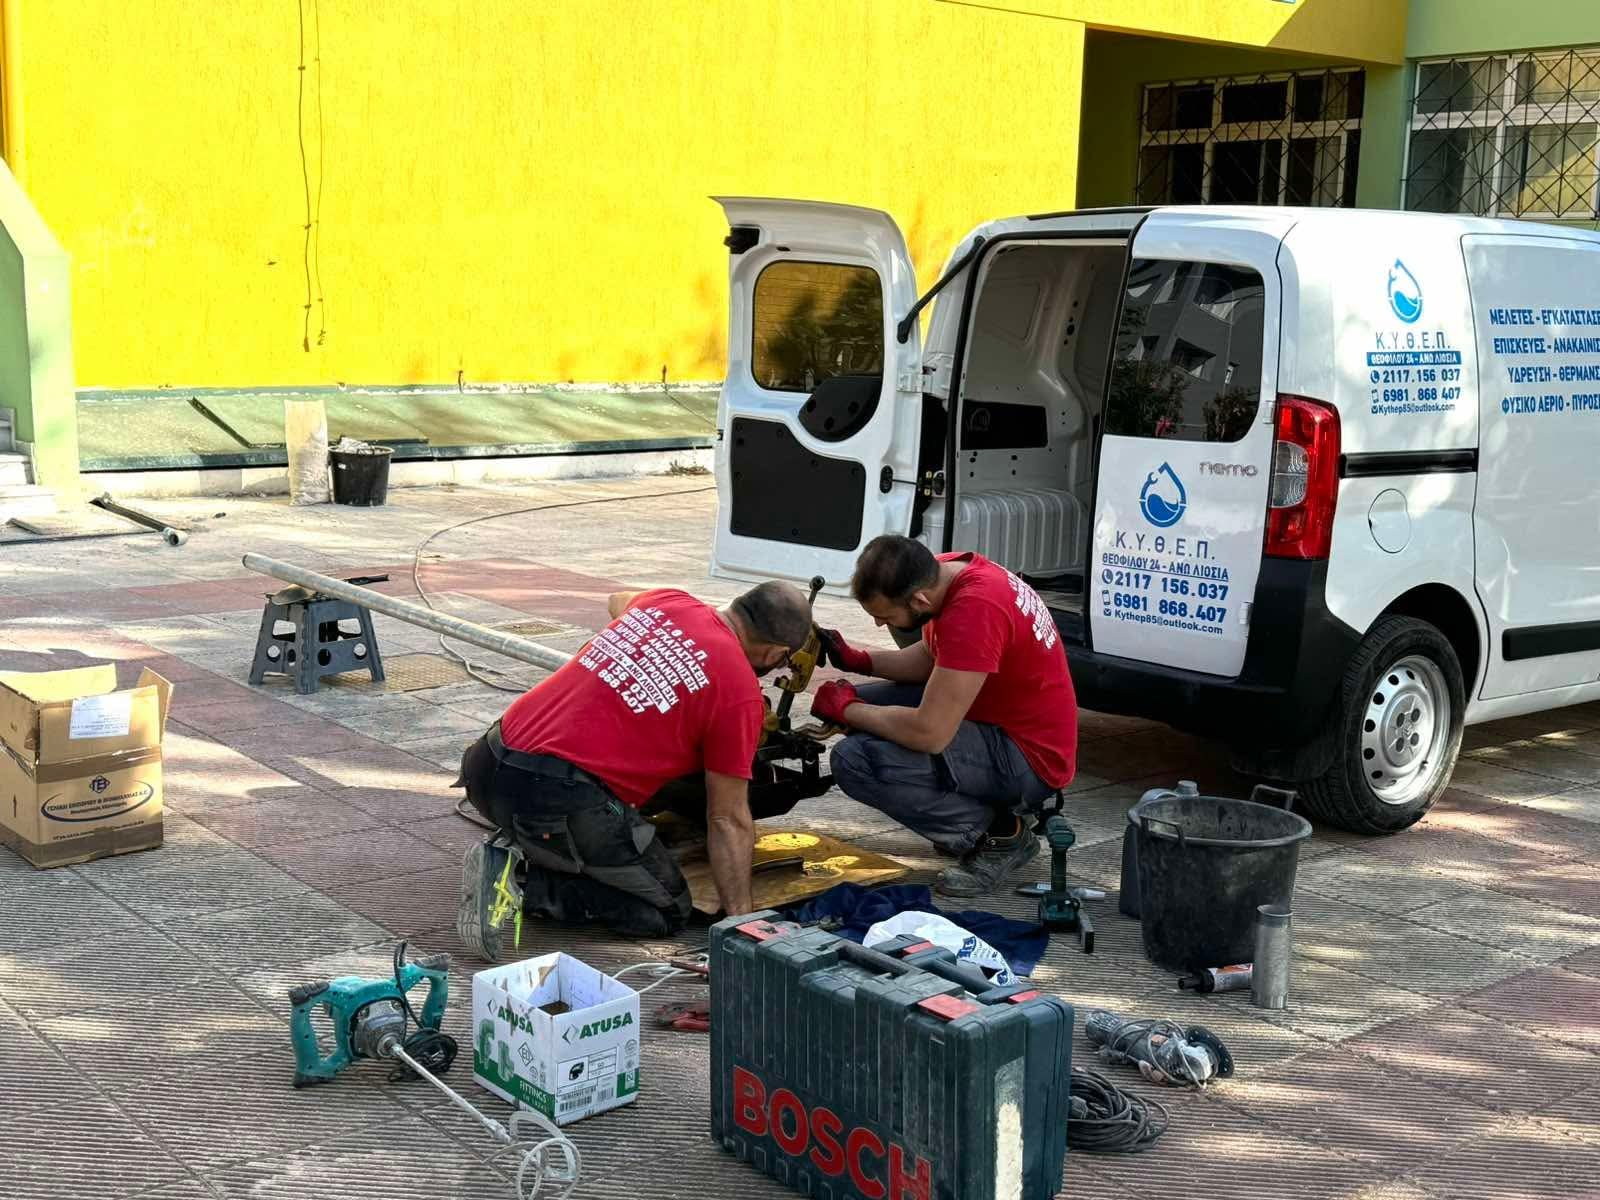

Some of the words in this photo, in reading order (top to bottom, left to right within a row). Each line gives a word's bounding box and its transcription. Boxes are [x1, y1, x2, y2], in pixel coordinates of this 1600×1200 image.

[1489, 309, 1534, 325] ΜΕΛΕΤΕΣ
[1375, 331, 1451, 350] Κ.Υ.Θ.Ε.Π.
[1494, 338, 1545, 354] ΕΠΙΣΚΕΥΕΣ
[1419, 352, 1434, 363] ΑΝΩ
[1441, 368, 1460, 382] 037
[1508, 367, 1551, 383] ΥΔΡΕΥΣΗ
[1441, 386, 1461, 400] 407
[1502, 396, 1536, 414] ΦΥΣΙΚΟ
[1538, 395, 1564, 412] ΑΕΡΙΟ
[1199, 462, 1258, 477] nemo
[1115, 531, 1215, 560] Κ.Υ.Θ.Ε.Π.
[1102, 552, 1148, 570] ΘΕΟΦΙΛΟΥ
[1150, 559, 1160, 570] 24
[1169, 562, 1190, 575] ΑΝΩ
[1194, 565, 1229, 580] ΛΙΟΣΙΑ
[1115, 571, 1151, 590] 2117
[1161, 577, 1229, 601] 156.037
[1113, 592, 1148, 611] 6981
[1159, 599, 1227, 623] 868.407
[1115, 610, 1223, 635] Kythep85@outlook.com
[640, 644, 681, 687] ΘΕΡΜΑΝΣΗ
[648, 638, 700, 694] ΑΝΑΚΑΙΝΙΣΕΙΣ
[652, 628, 710, 689] ΕΓΚΑΤΑΣΤΑΣΕΙΣ
[627, 663, 644, 680] ΑΝΩ
[640, 678, 663, 706] ΛΙΟΣΙΑ
[636, 656, 680, 706] ΠΥΡΟΣΒΕΣΗ
[498, 1006, 534, 1036] ATUSA
[579, 1012, 633, 1040] ATUSA
[733, 1064, 933, 1200] BOSCH
